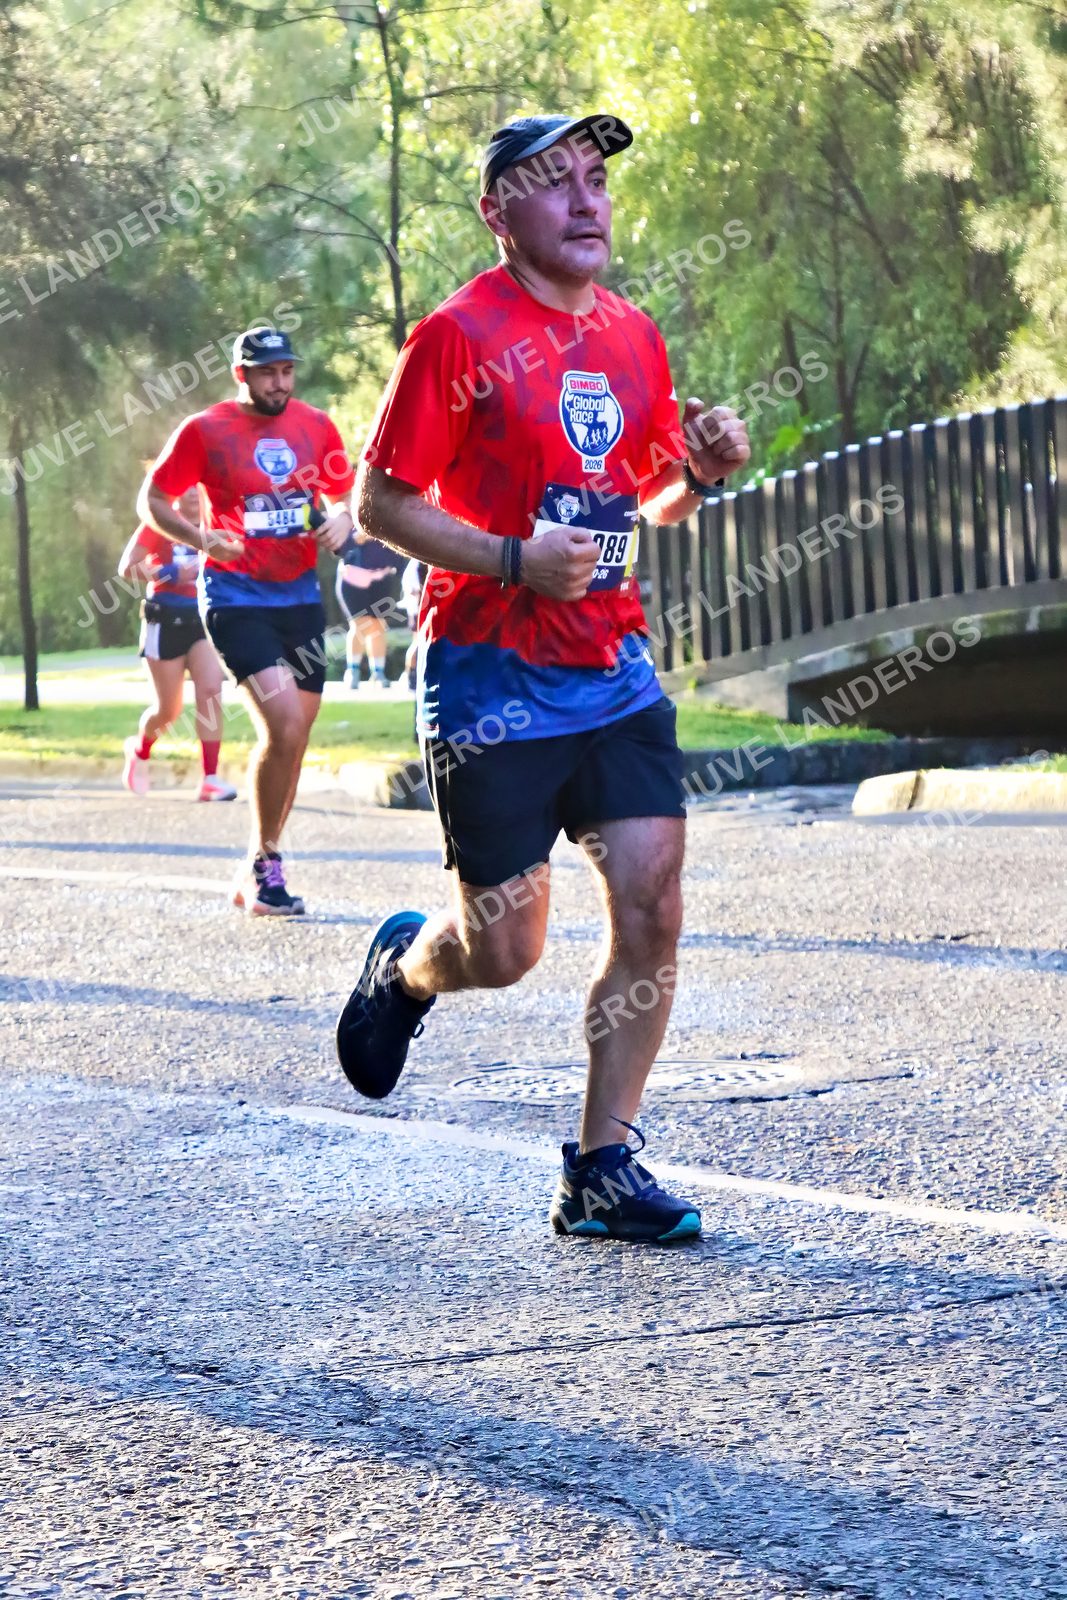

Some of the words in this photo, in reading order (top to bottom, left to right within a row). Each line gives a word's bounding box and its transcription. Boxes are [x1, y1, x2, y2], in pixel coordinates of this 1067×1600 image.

[569, 380, 603, 392] BIMBO
[573, 395, 606, 412] Global
[570, 408, 594, 424] Race
[584, 459, 603, 470] 2026
[267, 510, 296, 527] 5484
